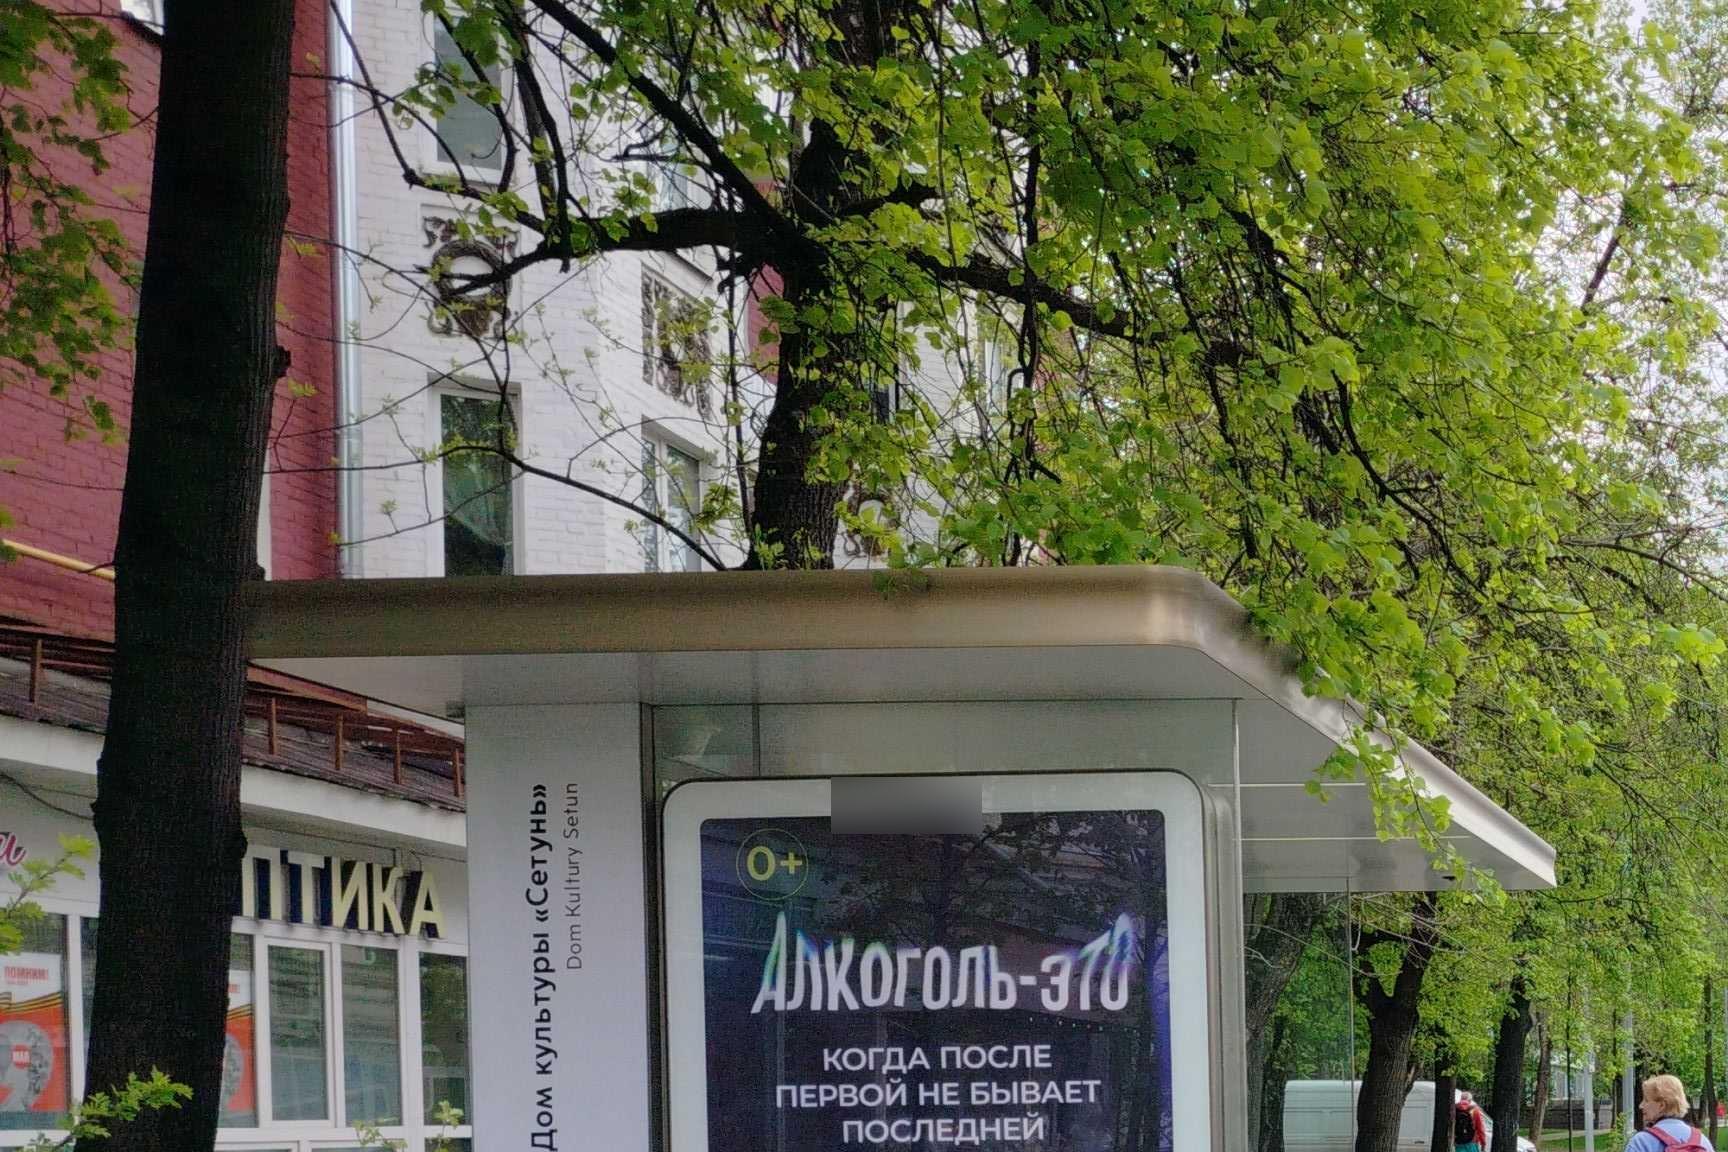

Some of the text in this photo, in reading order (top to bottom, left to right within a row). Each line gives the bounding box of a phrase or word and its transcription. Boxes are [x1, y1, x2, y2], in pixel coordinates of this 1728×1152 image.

[563, 783, 583, 970] Dom Kultury Setun
[746, 845, 804, 882] 0+
[242, 845, 449, 939] ПТИКА
[526, 783, 558, 1152] Дом культуры «Сетунь»
[823, 1044, 1052, 1074] КОГДА ПОСЛЕ
[776, 1077, 1101, 1109] ПЕРВОЙ НЕ БЫВАЕТ
[842, 1112, 1044, 1144] ПОСЛЕДНЕЙ
